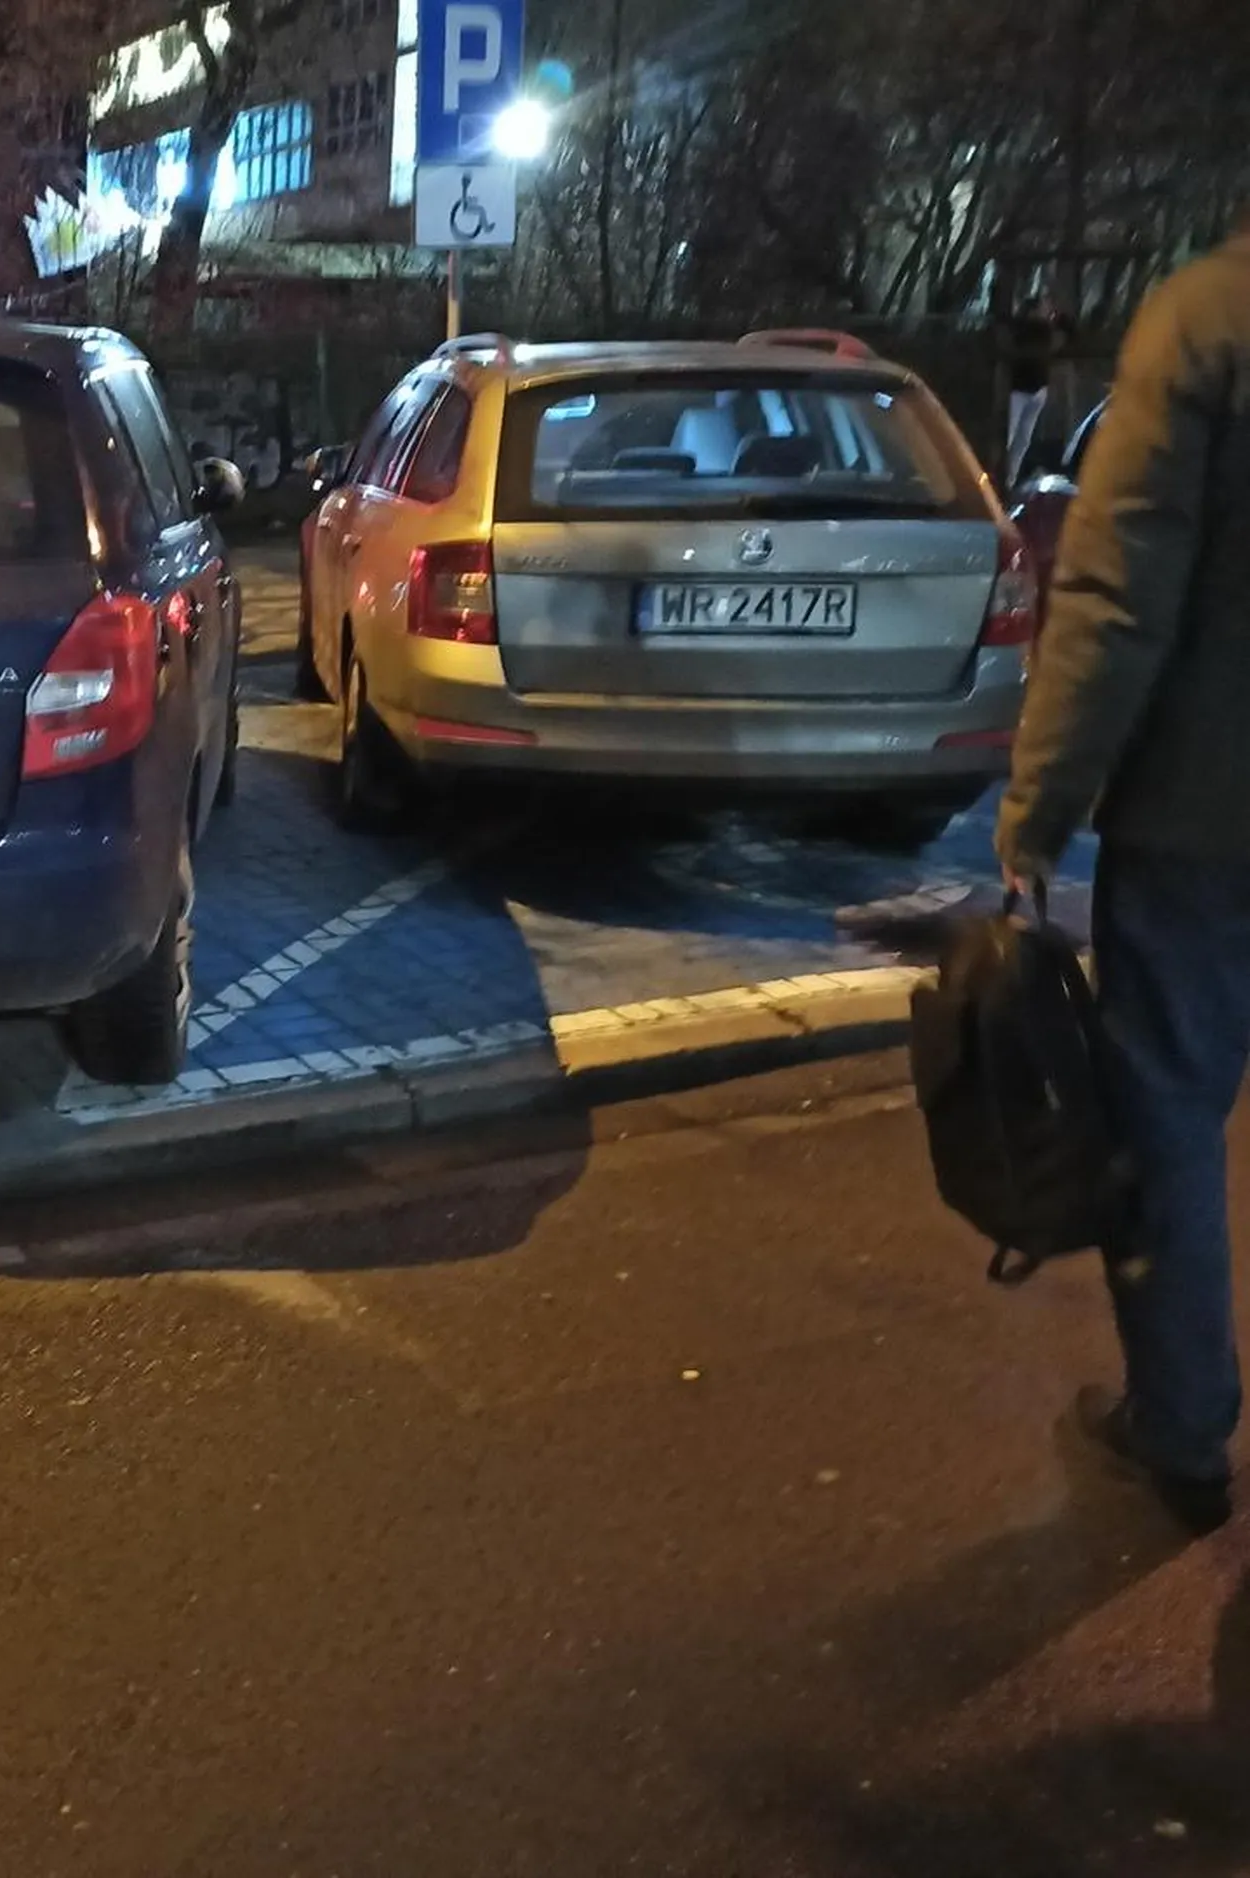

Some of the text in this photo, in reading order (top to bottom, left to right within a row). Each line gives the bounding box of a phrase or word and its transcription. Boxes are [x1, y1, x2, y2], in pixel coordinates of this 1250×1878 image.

[443, 4, 502, 114] P
[662, 585, 848, 625] WR 2417R
